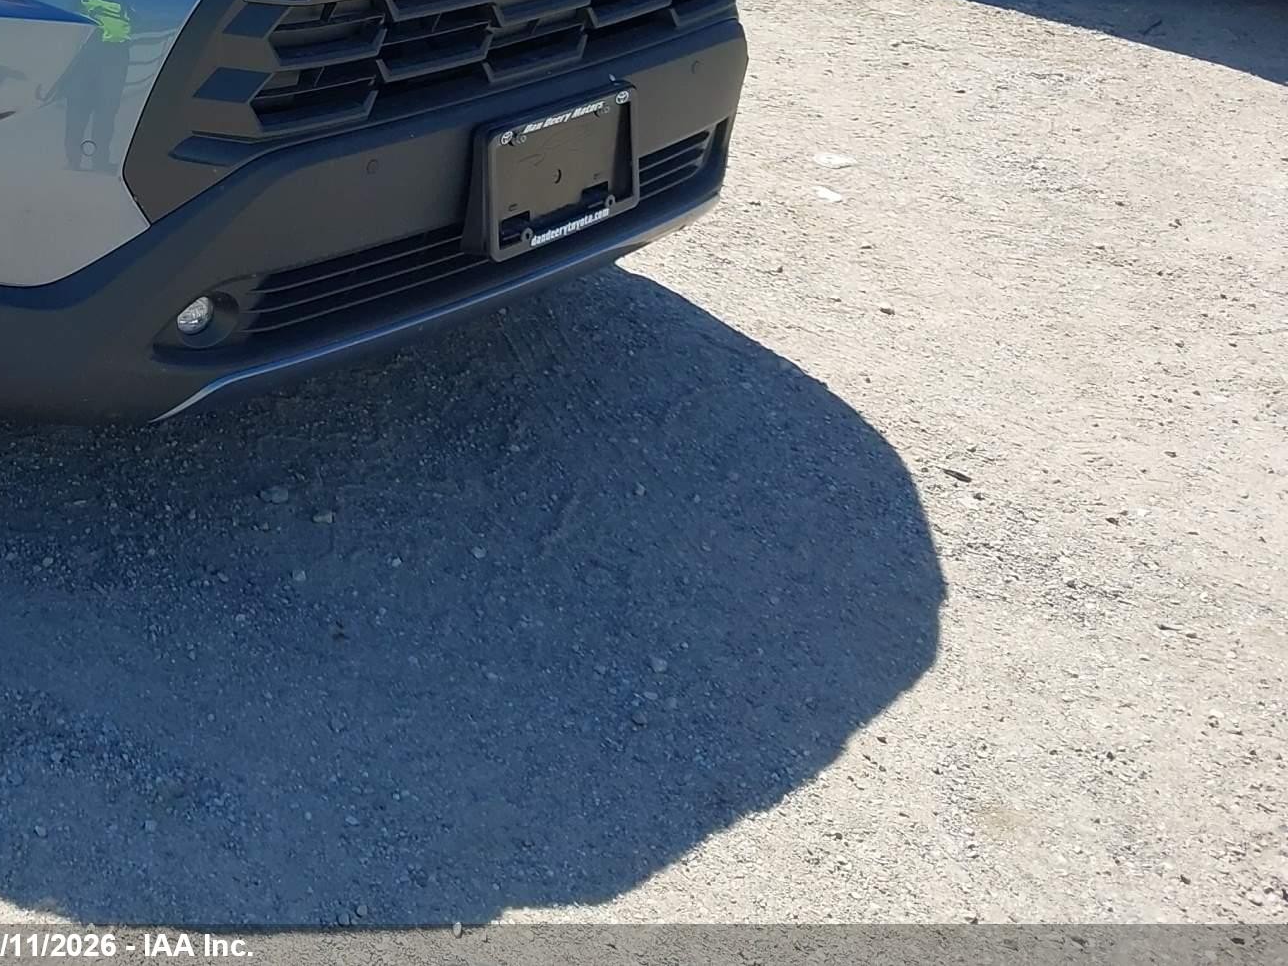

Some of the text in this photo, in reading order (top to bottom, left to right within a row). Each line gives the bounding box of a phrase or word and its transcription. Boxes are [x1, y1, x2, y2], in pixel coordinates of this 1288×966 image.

[523, 101, 605, 134] Dan Deery Motors
[530, 208, 610, 247] dandeerytoyota.com
